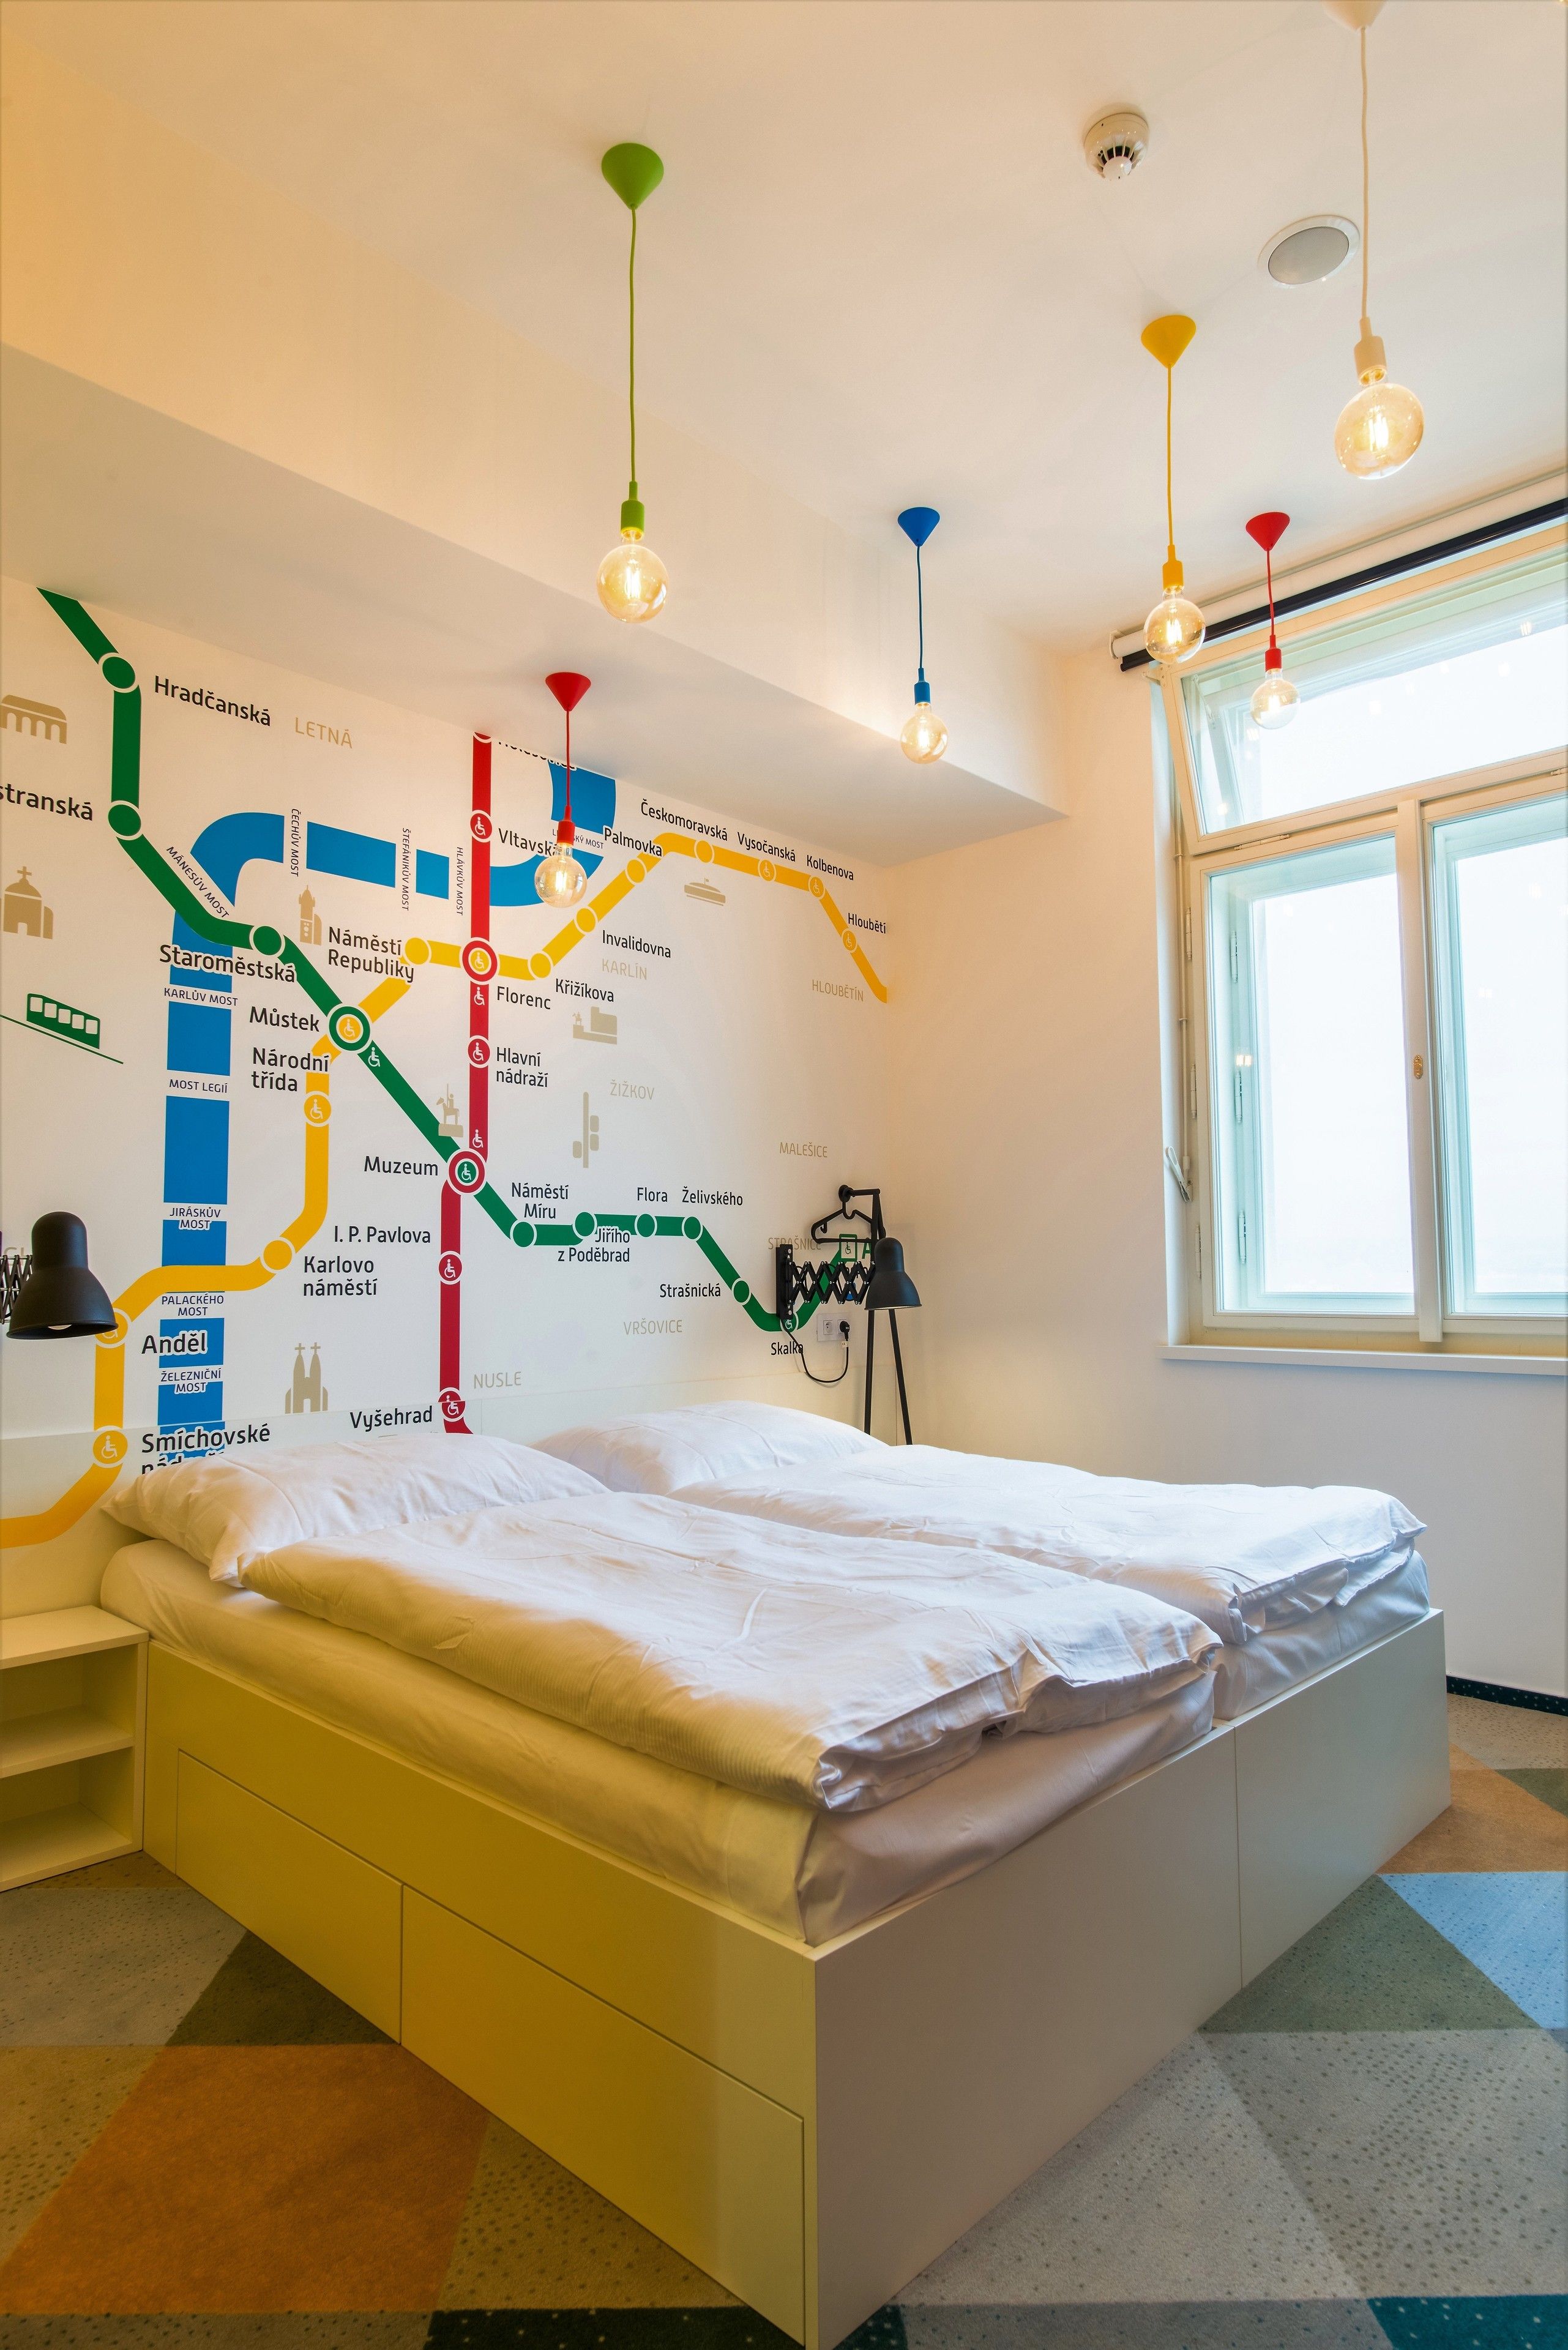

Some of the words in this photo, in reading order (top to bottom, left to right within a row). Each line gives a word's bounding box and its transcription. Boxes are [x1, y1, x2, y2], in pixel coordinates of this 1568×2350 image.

[155, 675, 271, 726] Hradčanská
[295, 717, 353, 749] LETNÁ
[291, 808, 301, 847] ČECHŮV
[641, 799, 728, 841] Českomoravská
[586, 837, 604, 849] MOST
[605, 827, 662, 857] Palmovka
[737, 831, 796, 862] Vysočanská
[291, 848, 299, 876] MOST
[402, 828, 411, 883] ŠTEFÁNIKŮV
[456, 847, 465, 889] HLÁVKŮV
[807, 854, 854, 881] Kolbenova
[166, 846, 207, 891] MÁNESŮV
[204, 893, 230, 919] MOST
[848, 912, 886, 934] Hloubětí
[329, 926, 402, 956] Náměstí
[602, 930, 671, 958] Invalidovna
[159, 944, 295, 983] Staroměstská
[328, 949, 414, 983] Republiky
[602, 958, 647, 980] KARLÍN
[164, 987, 206, 1002] KARLŮV
[209, 994, 238, 1006] MOST
[497, 985, 551, 1010] Florenc
[556, 978, 614, 1002] Křižíkova
[812, 979, 864, 1002] HLOUBĚTÍN
[249, 1006, 319, 1032] Můstek
[253, 1046, 329, 1072] Národní
[496, 1046, 541, 1067] Hlavní
[169, 1079, 199, 1091] MOST
[202, 1082, 228, 1094] LEGIÍ
[252, 1070, 297, 1092] třída
[496, 1068, 548, 1087] nádraží
[610, 1079, 655, 1100] ŽIŽKOV
[779, 1141, 828, 1158] MALEŠICE
[364, 1155, 439, 1176] Muzeum
[512, 1182, 569, 1199] Náměstí
[637, 1187, 668, 1203] Flora
[682, 1185, 743, 1206] Želivského
[169, 1206, 221, 1218] JIRÁSKŮV
[524, 1203, 556, 1219] Míru
[180, 1219, 211, 1229] MOST
[334, 1225, 343, 1243] I.
[349, 1225, 362, 1243] P.
[367, 1226, 431, 1244] Pavlova
[595, 1228, 630, 1244] Jiřího
[304, 1255, 374, 1274] Karlovo
[558, 1250, 565, 1262] z
[569, 1247, 630, 1263] Poděbrad
[304, 1278, 378, 1297] náměstí
[660, 1283, 721, 1298] Strašnická
[162, 1293, 224, 1305] PALACKÉHO
[177, 1307, 208, 1316] MOST
[623, 1318, 683, 1335] VRŠOVICE
[141, 1332, 206, 1354] Anděl
[771, 1341, 804, 1356] Skalka
[160, 1367, 222, 1382] ŽELEZNIČNÍ
[474, 1371, 521, 1389] NUSLE
[176, 1382, 206, 1393] MOST
[349, 1405, 433, 1433] Vyšehrad
[141, 1423, 271, 1453] Smíchovské
